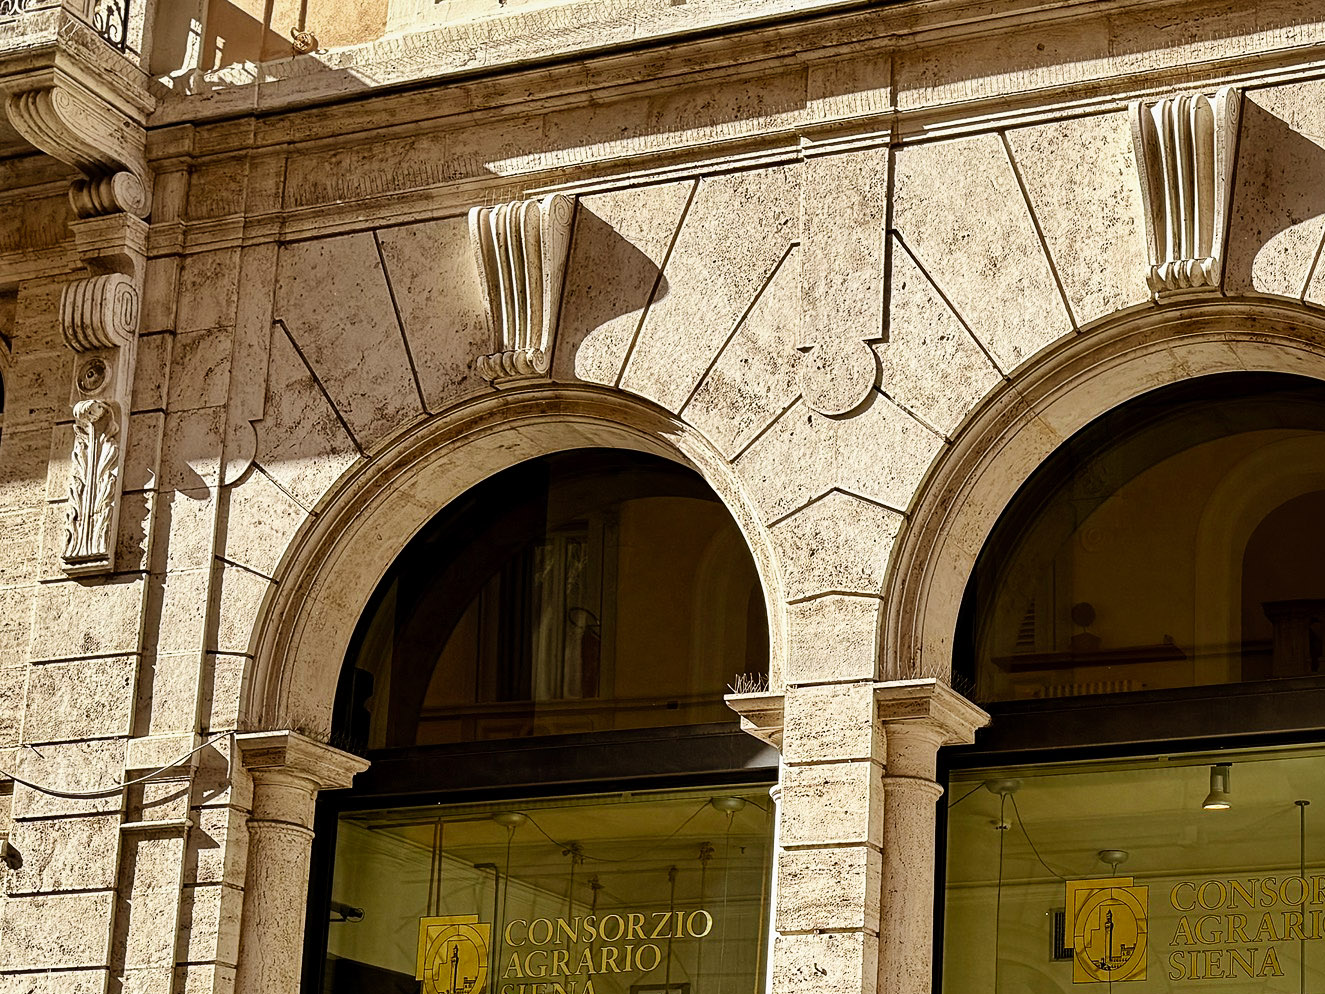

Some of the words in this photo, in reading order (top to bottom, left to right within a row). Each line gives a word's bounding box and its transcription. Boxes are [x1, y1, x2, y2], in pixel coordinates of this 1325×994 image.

[503, 908, 713, 948] CONSORZIO
[501, 943, 662, 979] AGRARIO
[1167, 946, 1285, 982] SIENA
